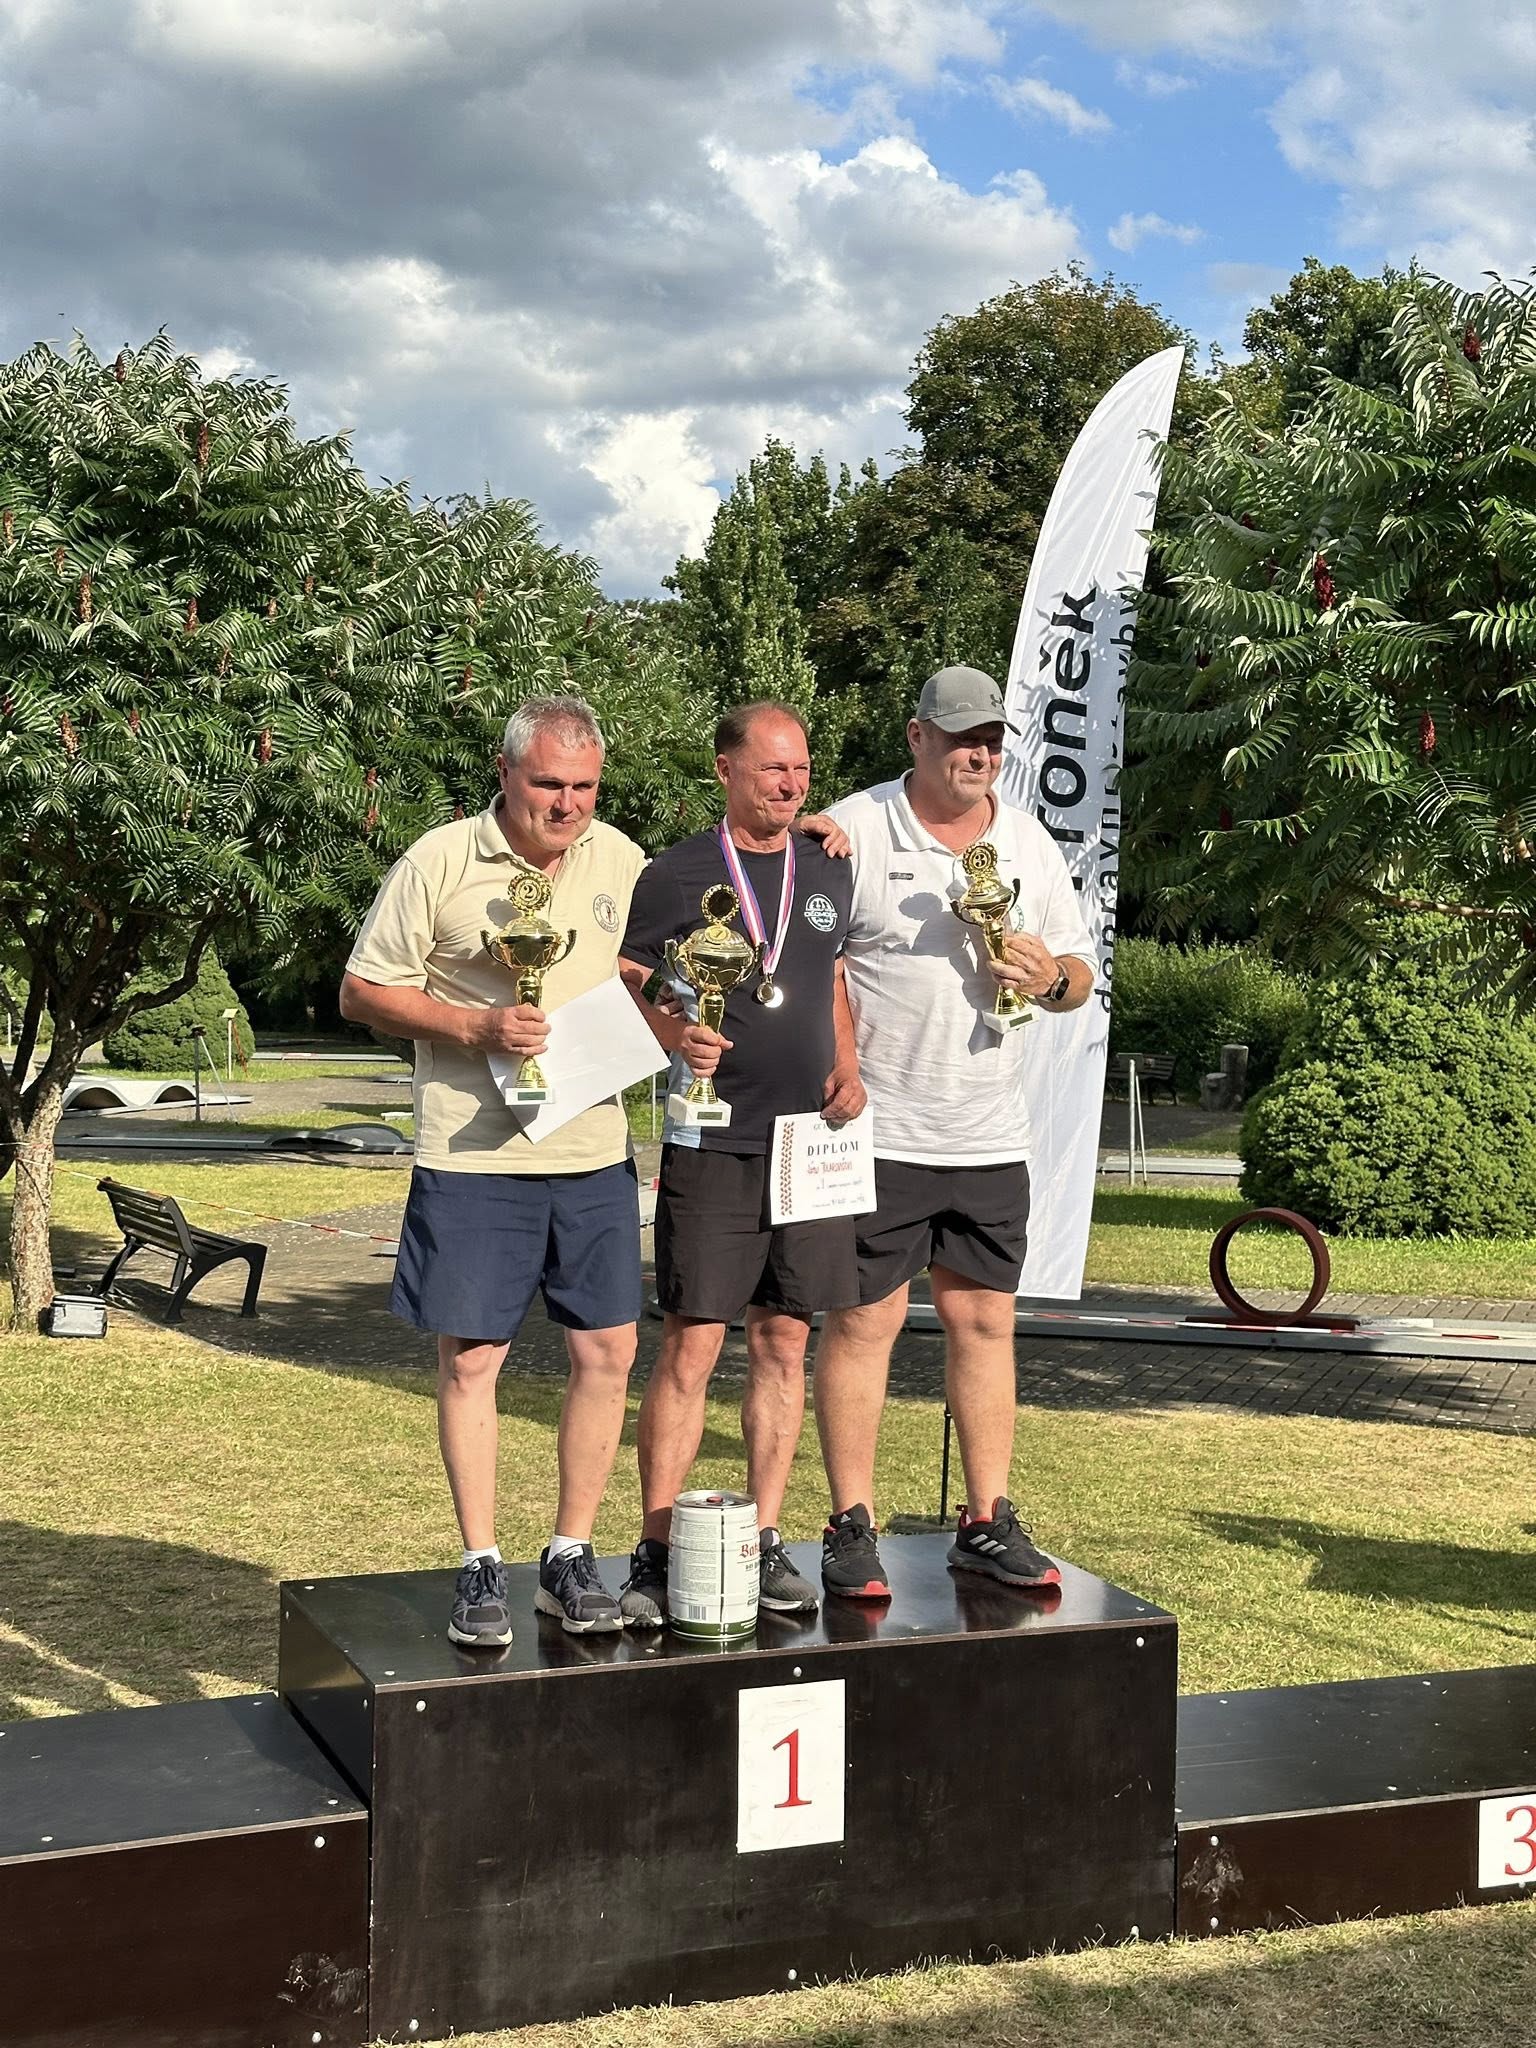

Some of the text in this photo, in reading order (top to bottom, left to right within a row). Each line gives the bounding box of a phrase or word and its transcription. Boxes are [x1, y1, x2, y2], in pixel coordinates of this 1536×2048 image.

[1038, 587, 1097, 891] roněk
[975, 853, 986, 867] 3
[523, 885, 534, 899] 2
[807, 1140, 859, 1157] DIPLOM
[772, 1728, 813, 1809] 1
[1505, 1805, 1536, 1876] 3
